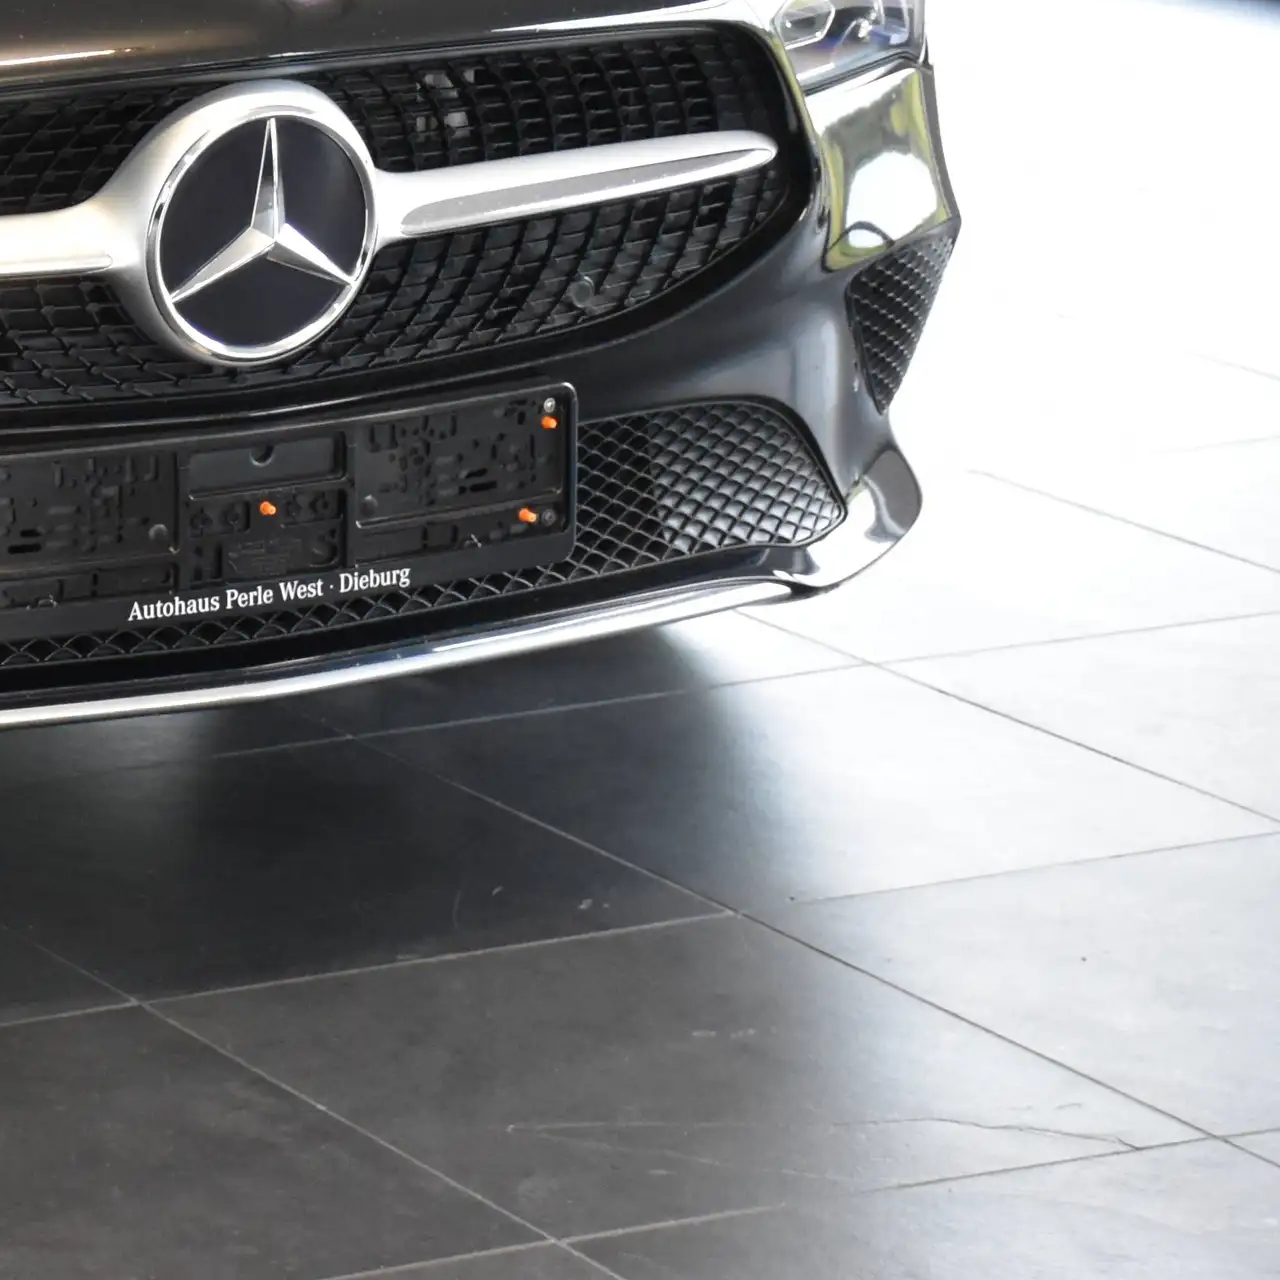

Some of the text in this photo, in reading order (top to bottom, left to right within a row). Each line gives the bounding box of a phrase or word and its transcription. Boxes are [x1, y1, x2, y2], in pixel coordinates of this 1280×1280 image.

[128, 595, 220, 621] Autohaus
[225, 585, 273, 610] Perle
[279, 578, 324, 602] West
[339, 568, 411, 594] Dieburg
